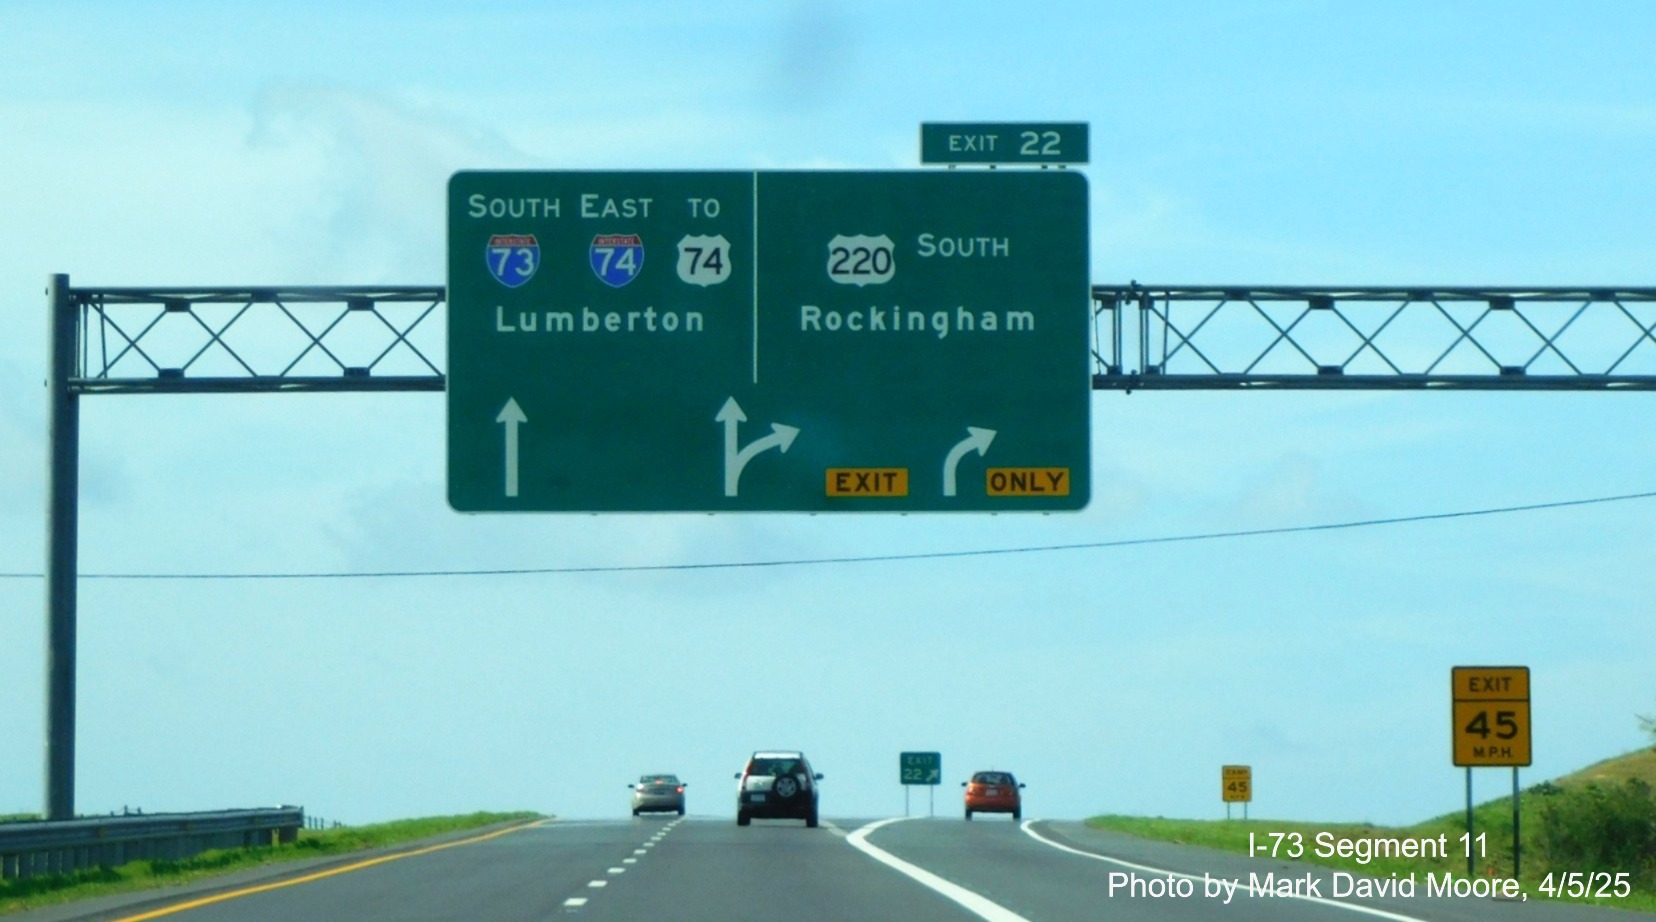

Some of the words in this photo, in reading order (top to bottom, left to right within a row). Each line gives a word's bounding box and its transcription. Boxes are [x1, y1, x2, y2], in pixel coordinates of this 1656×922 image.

[949, 135, 998, 151] EXIT
[1020, 131, 1061, 155] 22
[468, 193, 560, 218] SOUTH
[581, 193, 653, 218] EAST
[688, 198, 720, 218] TO
[494, 237, 531, 246] INTERSTATE
[597, 237, 635, 246] INTERSTATE
[918, 233, 1009, 257] SOUTH
[491, 248, 535, 277] 73
[594, 248, 636, 277] 74
[683, 247, 724, 276] 74
[831, 246, 892, 275] 220
[496, 306, 704, 333] Lumberton
[800, 305, 1035, 340] Rockingham
[835, 472, 898, 493] EXIT
[990, 472, 1065, 493] ONLY
[1468, 676, 1512, 693] EXIT
[1465, 710, 1518, 740] 45
[903, 768, 923, 780] 22
[1227, 780, 1248, 793] 45
